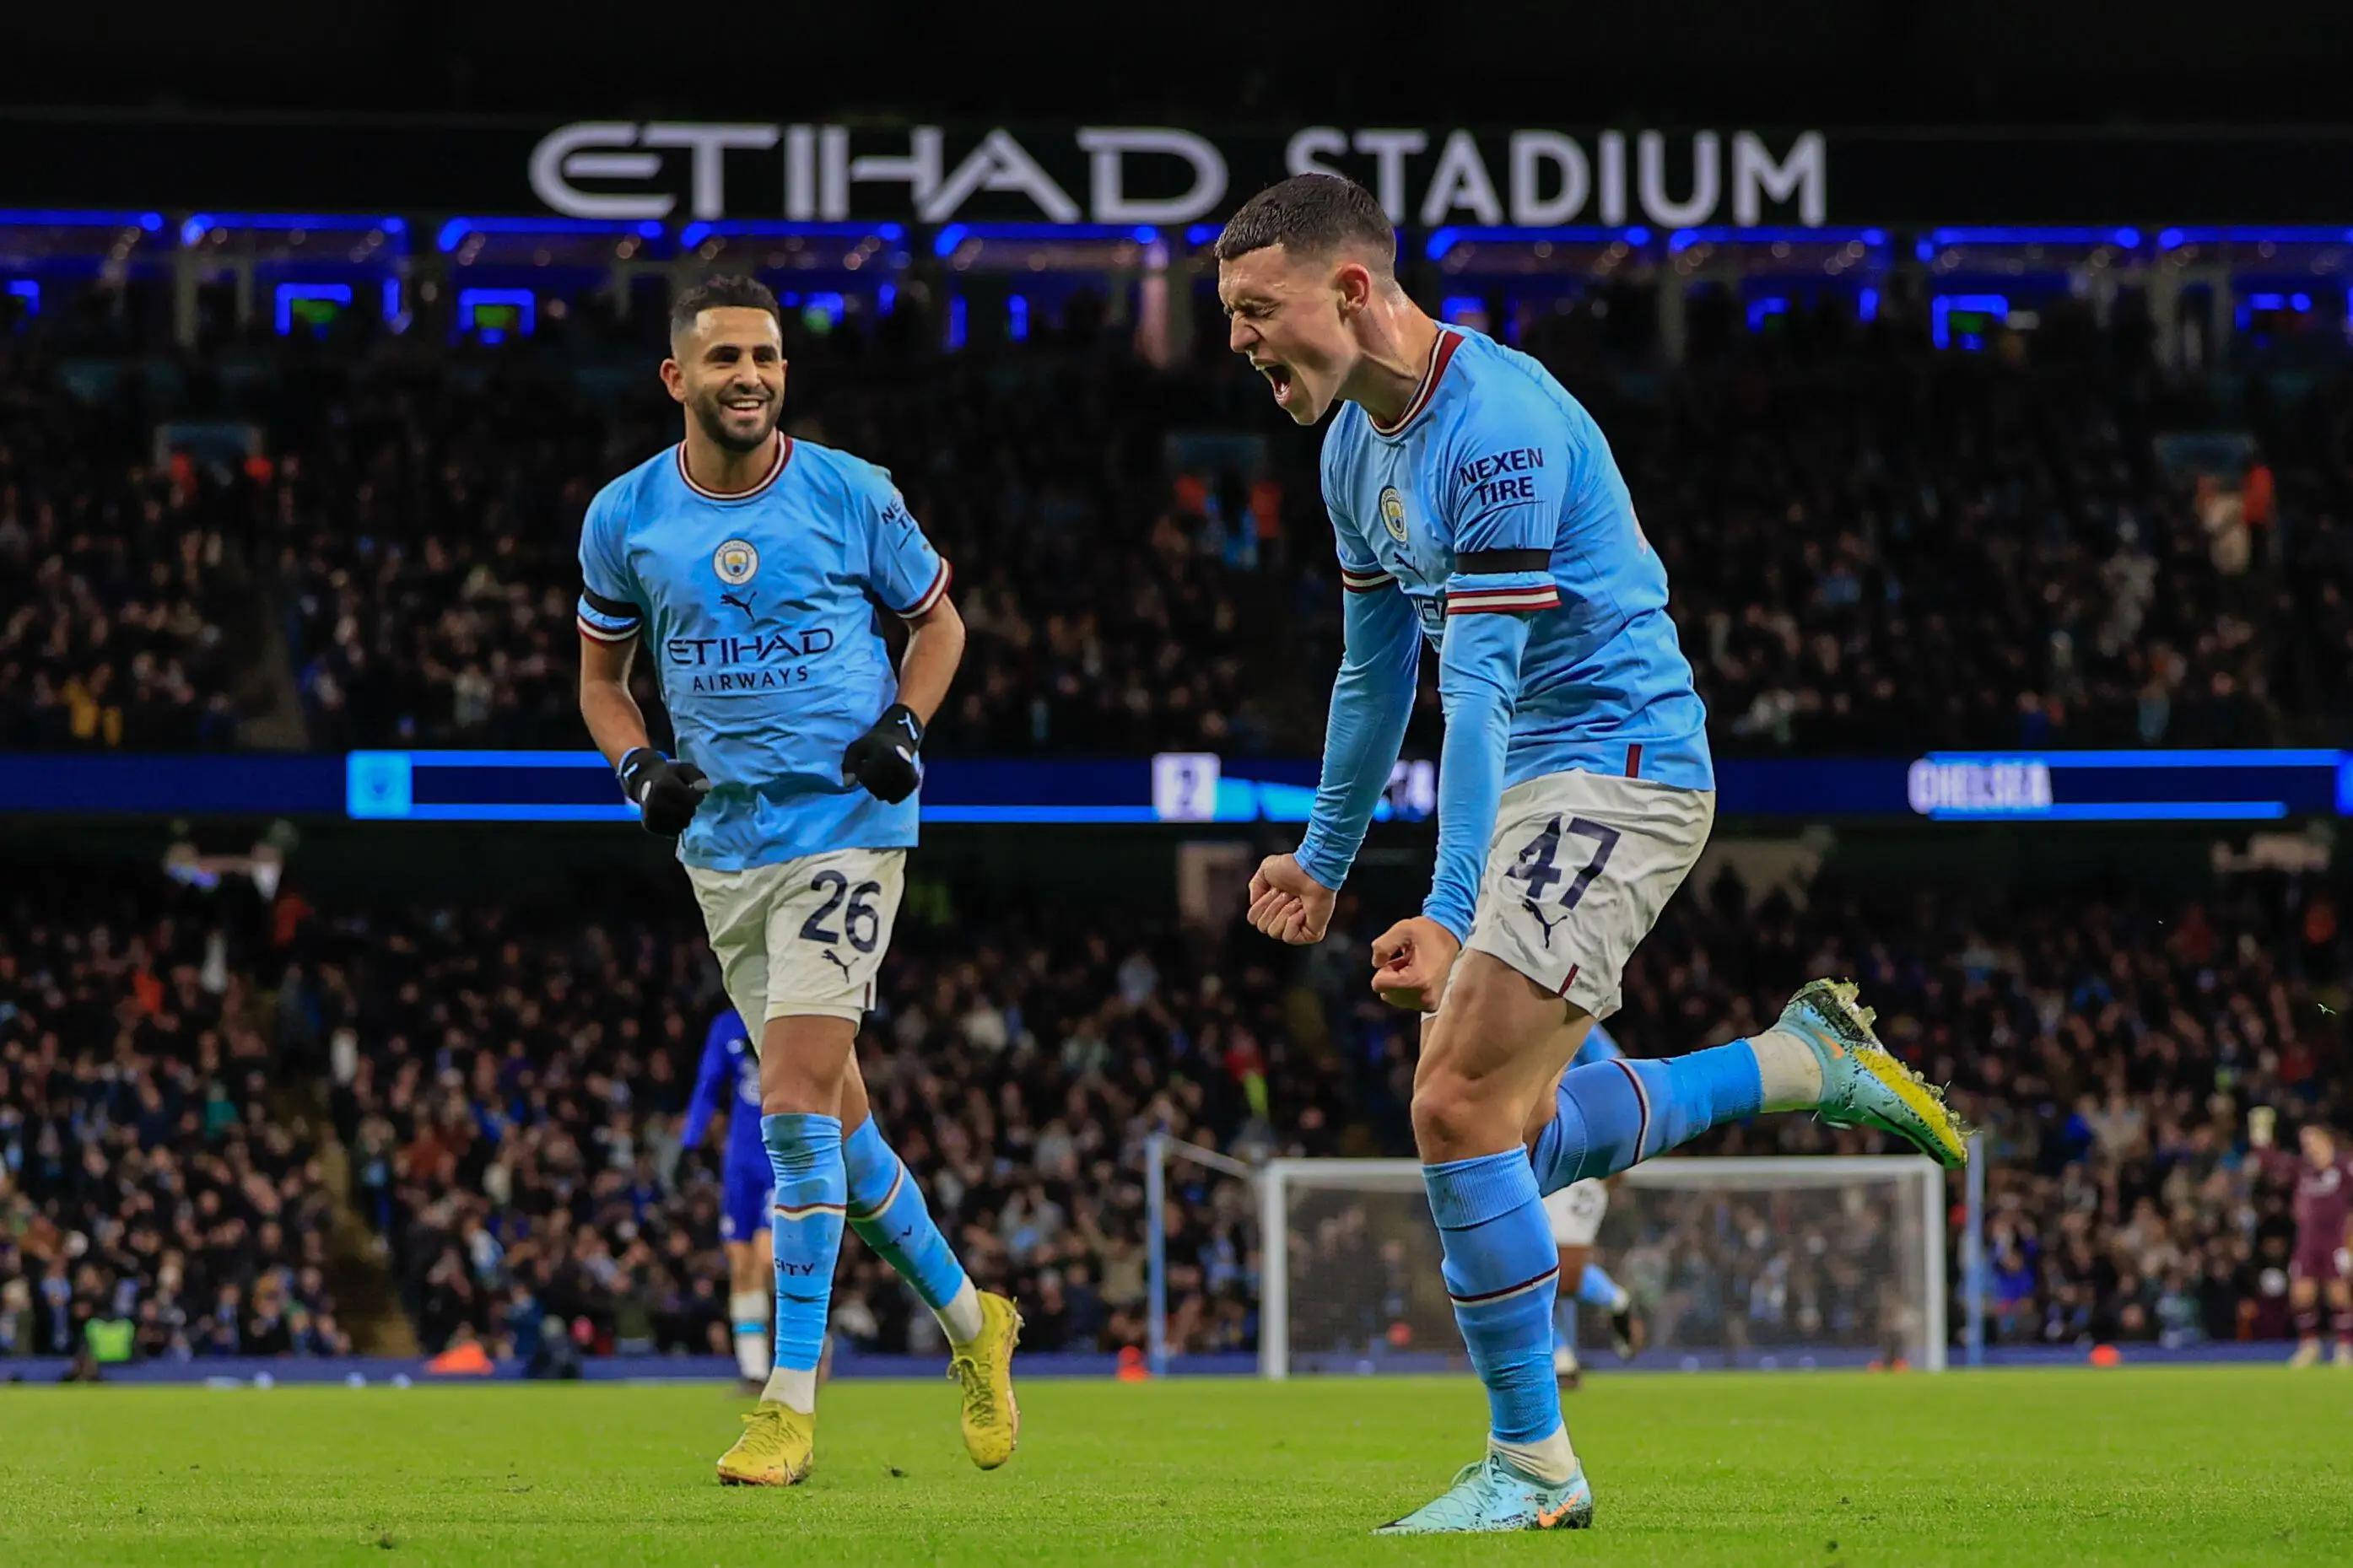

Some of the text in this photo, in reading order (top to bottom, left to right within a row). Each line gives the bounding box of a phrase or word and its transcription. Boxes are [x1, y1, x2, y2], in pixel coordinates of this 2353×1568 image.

[526, 121, 1229, 225] ETIHAD
[1460, 448, 1543, 487] NEXEN
[1476, 477, 1534, 506] TIRE
[667, 628, 834, 665] ETIHAD
[693, 665, 809, 692] AIRWAYS
[1506, 816, 1622, 910] 47
[799, 870, 881, 953] 26
